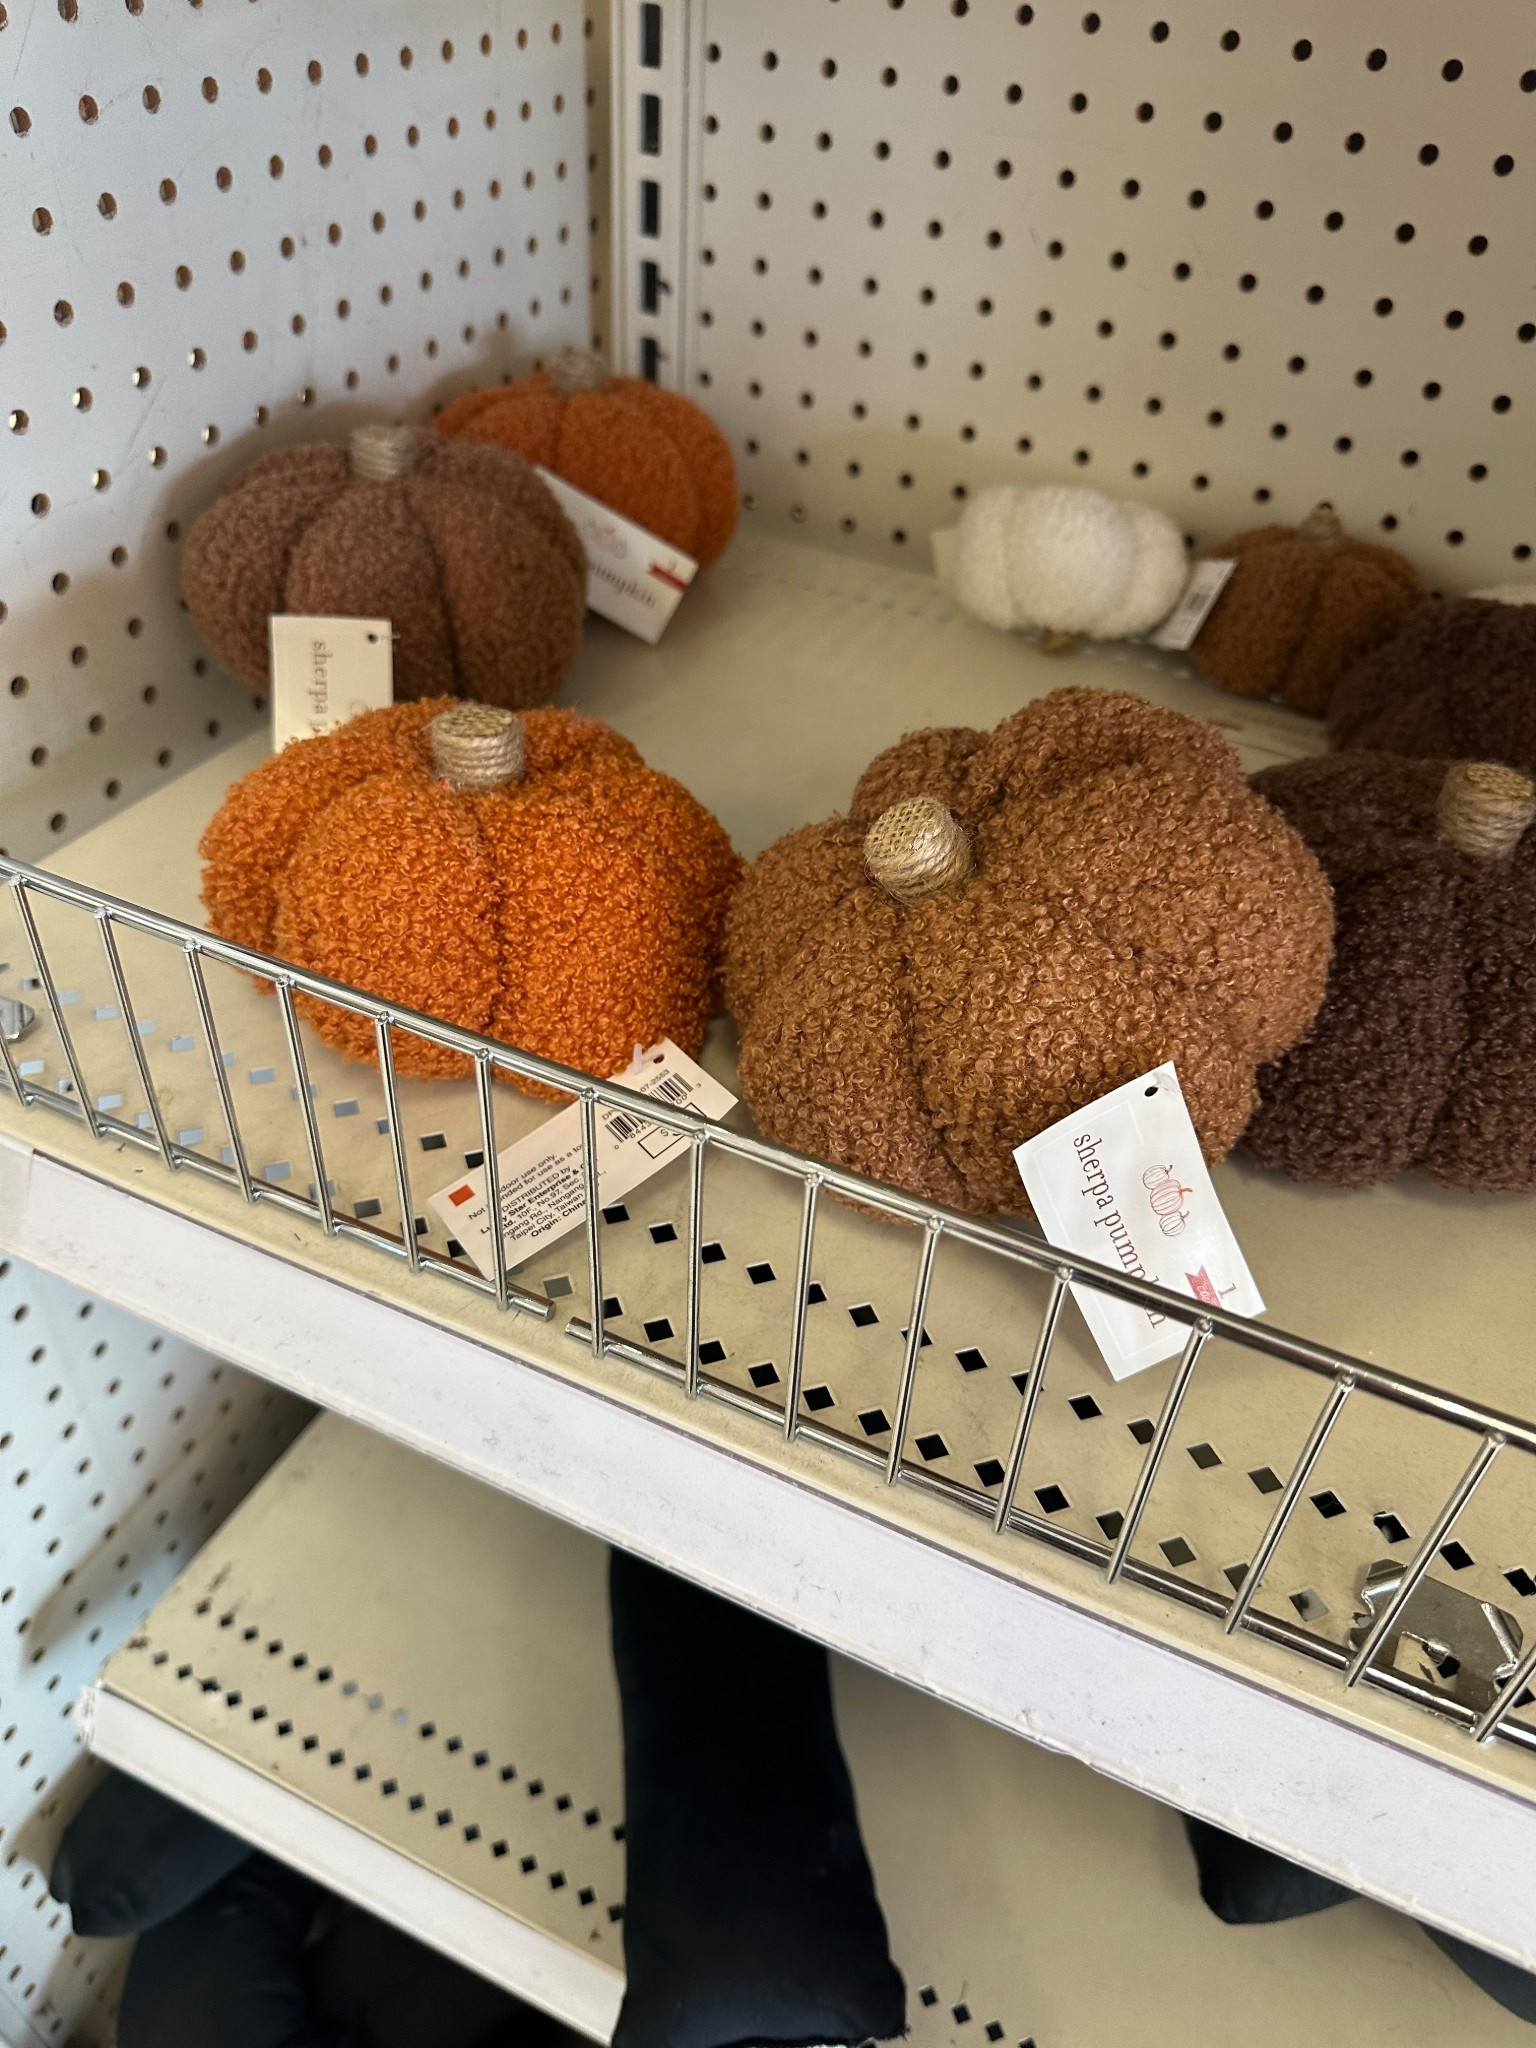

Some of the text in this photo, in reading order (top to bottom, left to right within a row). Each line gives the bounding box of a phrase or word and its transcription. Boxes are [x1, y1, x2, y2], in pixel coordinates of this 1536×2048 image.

[309, 641, 333, 714] sherpa
[521, 1167, 536, 1178] use
[538, 1154, 557, 1167] only.
[562, 1177, 582, 1190] Sec.
[468, 1207, 485, 1220] Not
[523, 1175, 535, 1184] for
[537, 1165, 553, 1176] use
[554, 1157, 565, 1165] as
[501, 1166, 570, 1212] DISTRIBUTED by
[508, 1203, 526, 1216] Star
[527, 1175, 571, 1204] Enterprise
[548, 1183, 585, 1208] Nangang
[510, 1223, 535, 1240] Taipei
[555, 1193, 583, 1212] Taiwan
[531, 1216, 561, 1237] Origin:
[1073, 1134, 1167, 1328] sherpa pumpn
